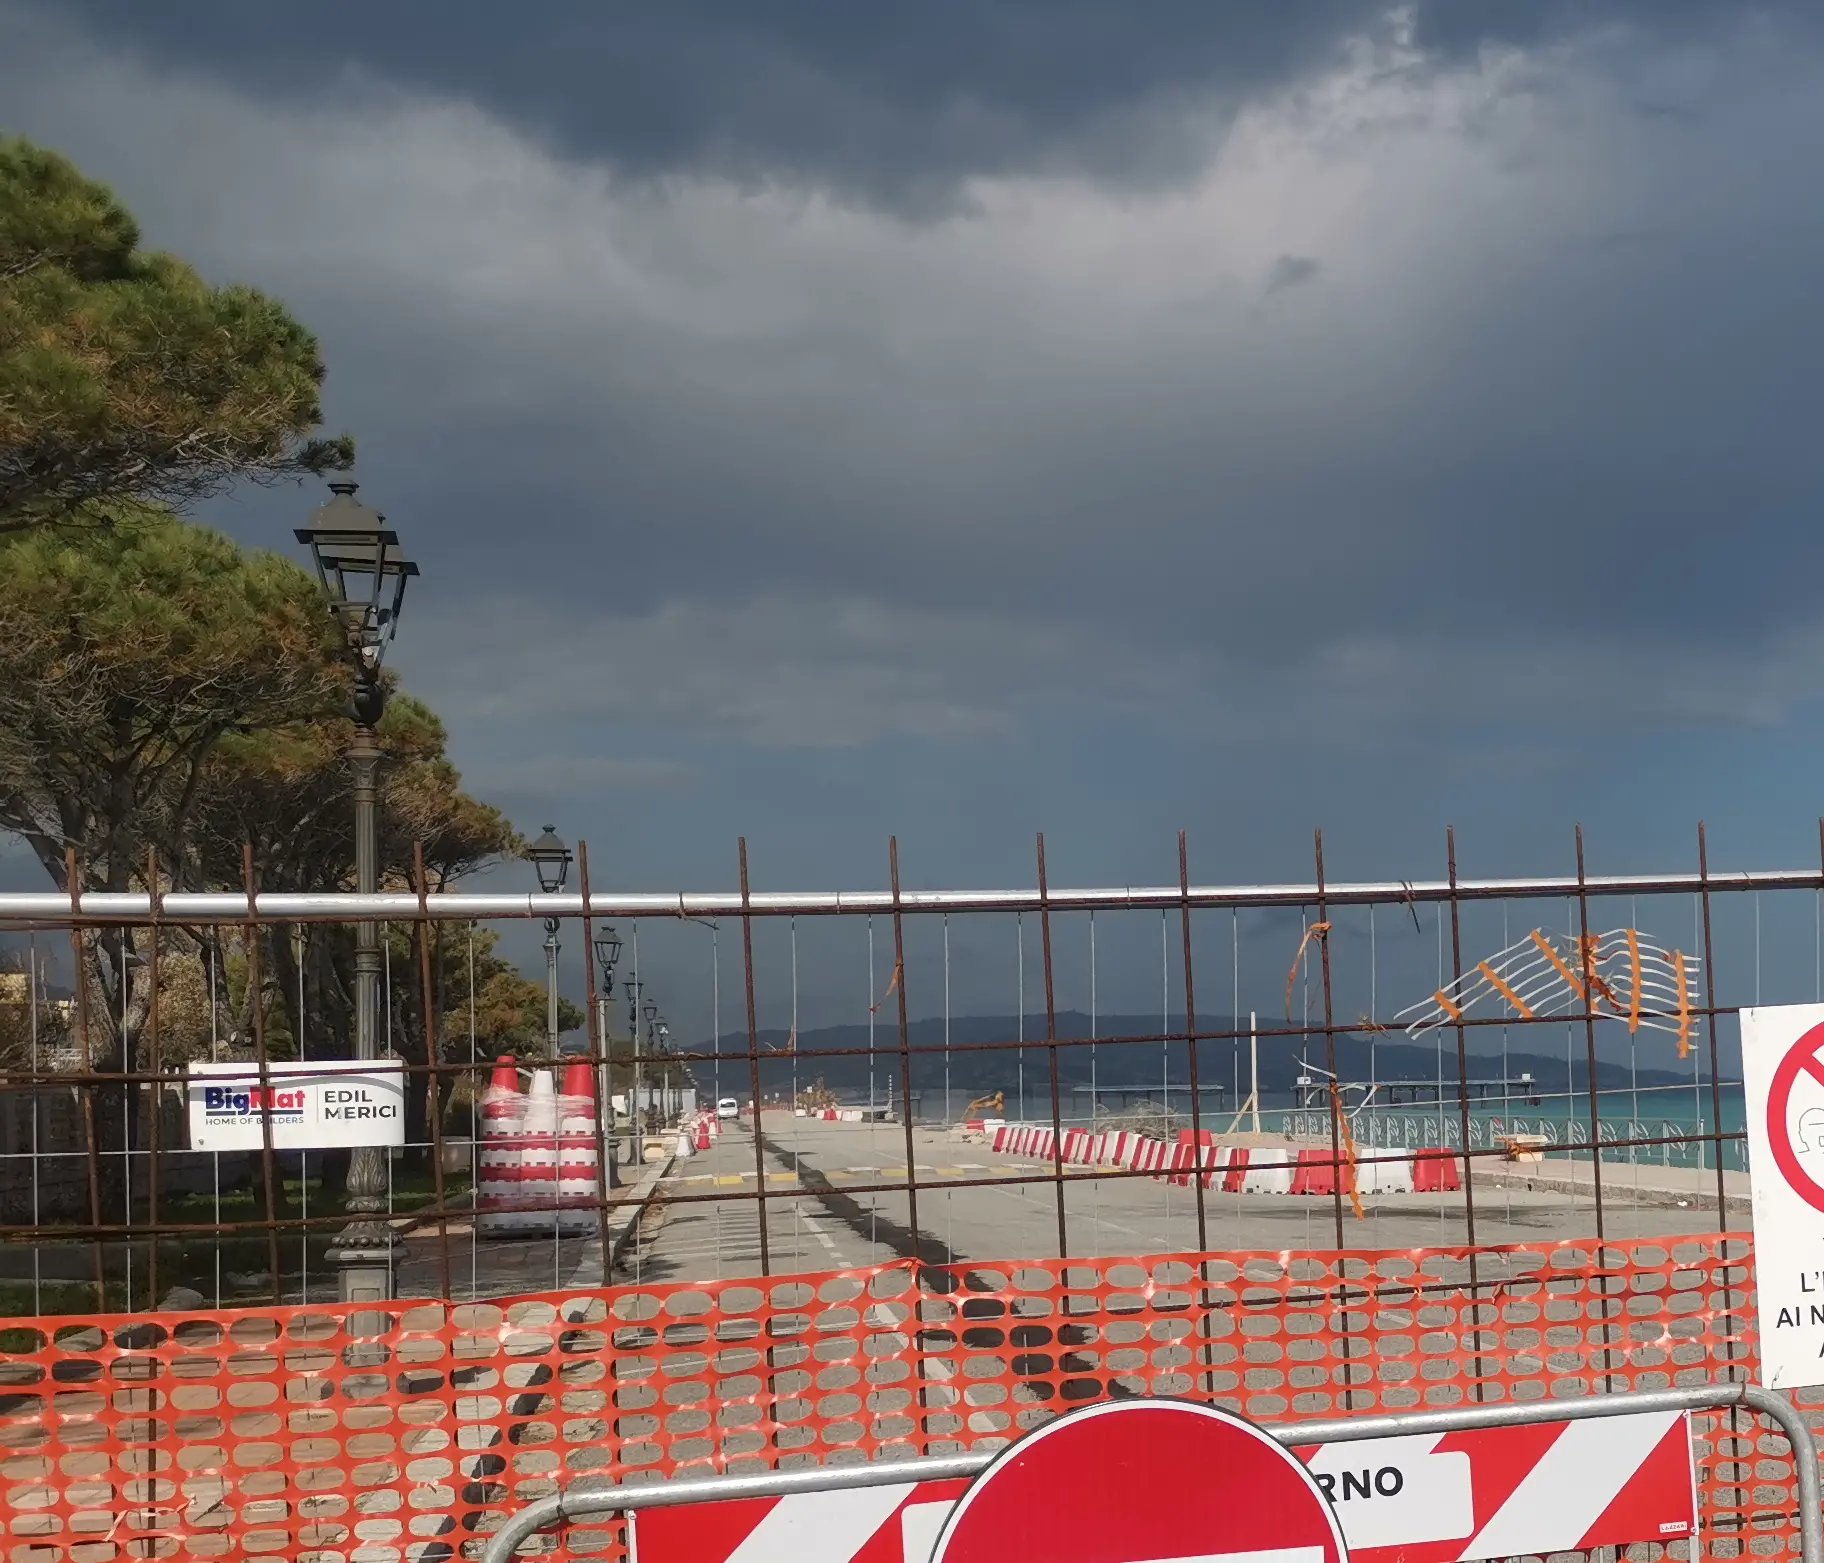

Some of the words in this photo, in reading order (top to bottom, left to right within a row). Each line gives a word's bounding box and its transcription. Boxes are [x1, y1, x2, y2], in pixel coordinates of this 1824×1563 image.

[205, 1087, 305, 1115] BigMat
[324, 1090, 373, 1103] EDIL
[325, 1105, 396, 1120] MERICI
[205, 1117, 237, 1126] HOME
[239, 1117, 253, 1125] OF
[256, 1116, 304, 1125] BILDERS
[1776, 1306, 1801, 1328] AI
